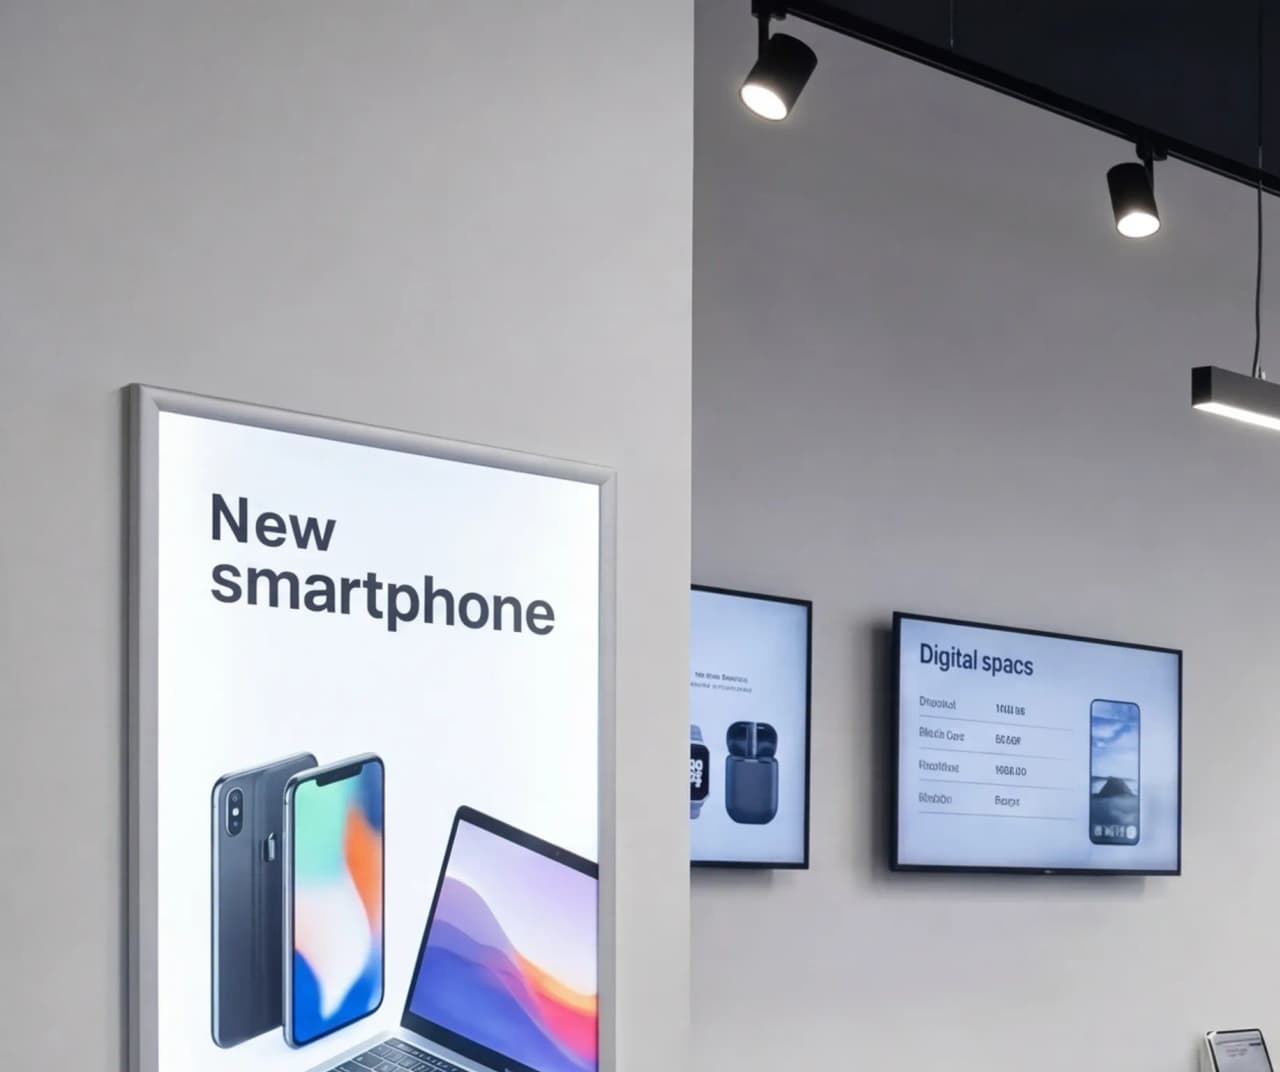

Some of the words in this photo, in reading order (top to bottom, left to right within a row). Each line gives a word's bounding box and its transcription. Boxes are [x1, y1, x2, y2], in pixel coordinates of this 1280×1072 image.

[211, 492, 337, 552] New
[210, 563, 556, 636] smartphone
[919, 642, 978, 672] Digital
